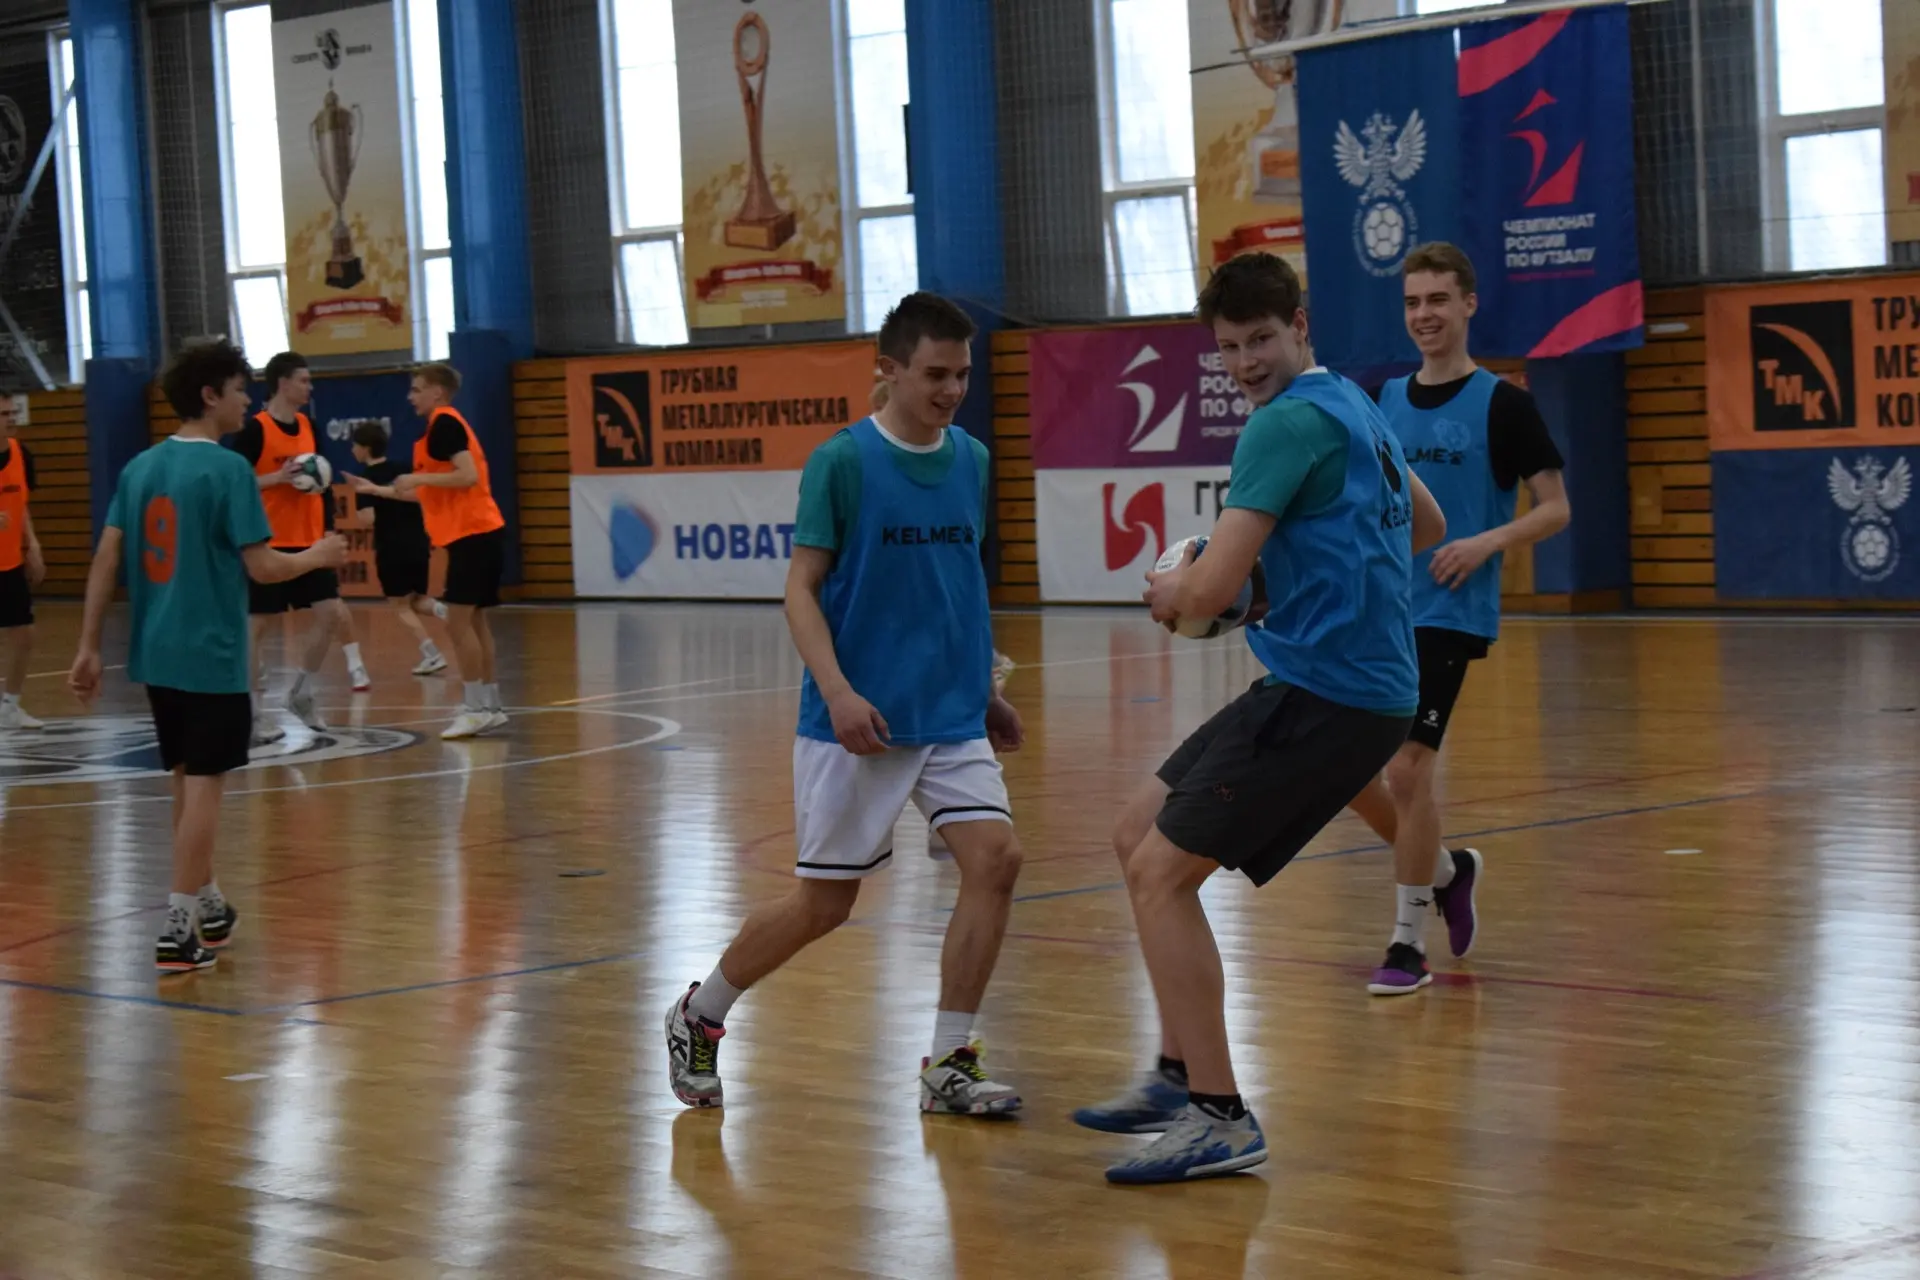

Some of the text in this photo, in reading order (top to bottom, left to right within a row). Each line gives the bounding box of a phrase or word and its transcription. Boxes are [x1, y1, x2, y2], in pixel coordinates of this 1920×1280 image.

[660, 366, 738, 394] ТРУБНАЯ
[1758, 359, 1825, 421] ТМК
[662, 397, 849, 430] МЕТАЛЛУРГИЧЕСКАЯ
[1876, 392, 1920, 428] КО
[597, 414, 636, 460] ТМК
[664, 437, 763, 466] КОМПАНИЯ
[143, 495, 179, 584] 9
[882, 525, 961, 546] KELME
